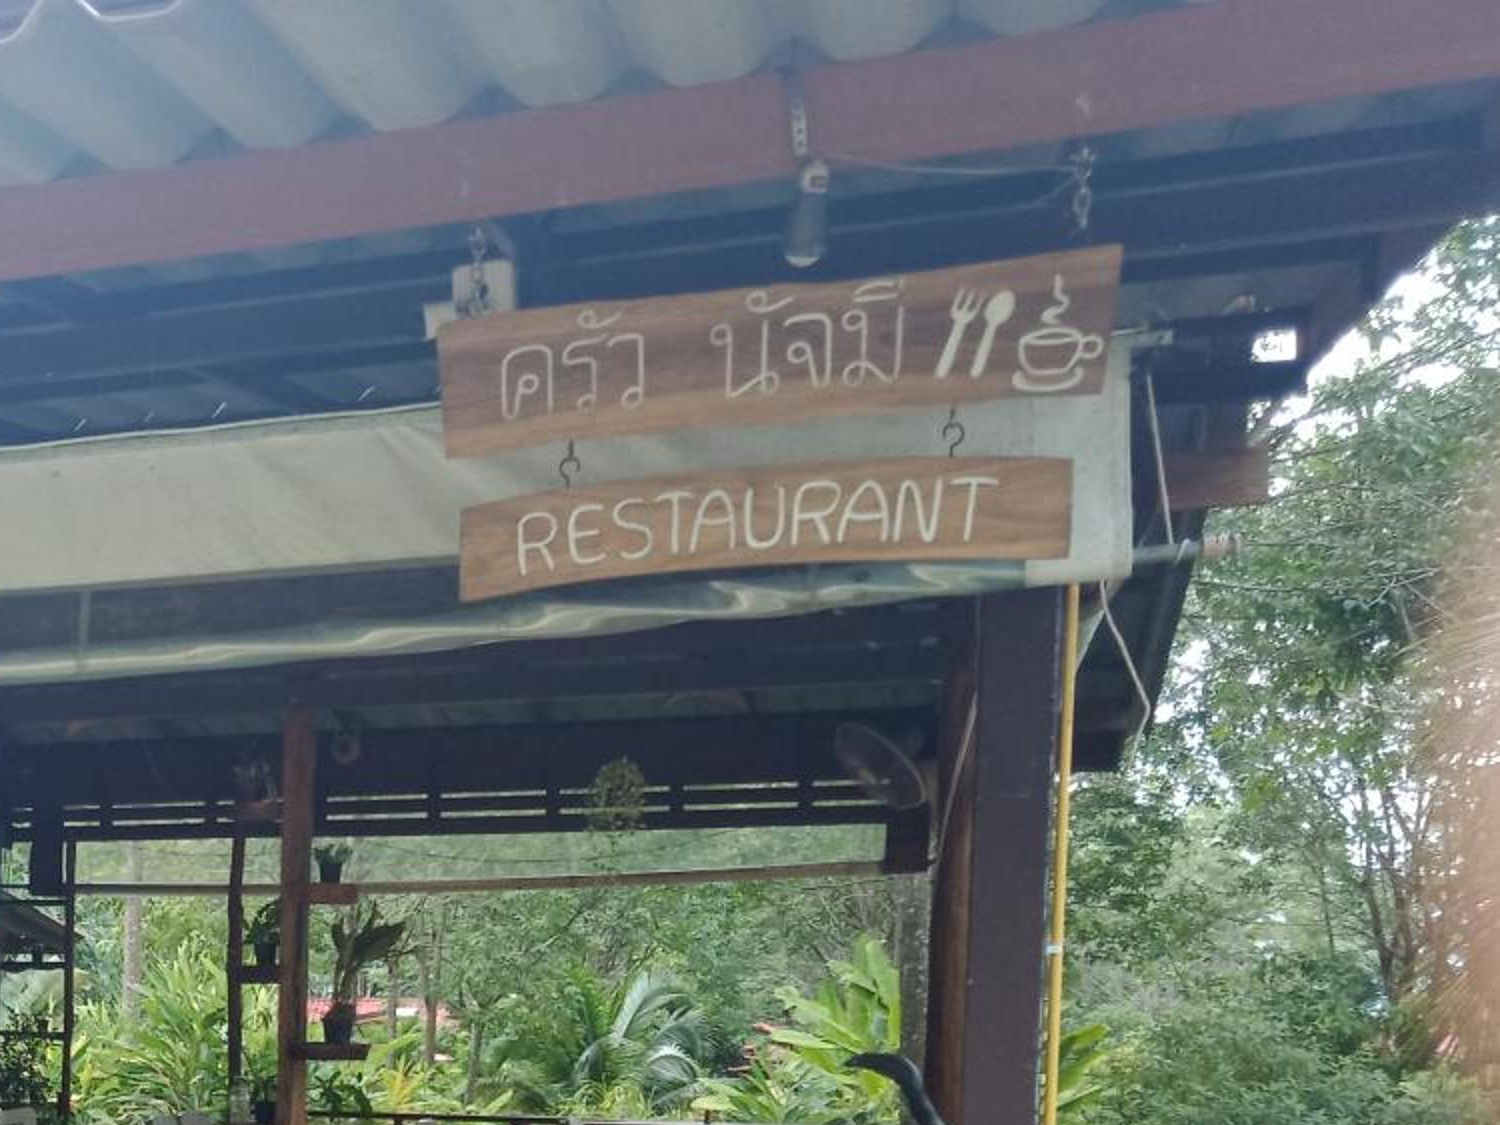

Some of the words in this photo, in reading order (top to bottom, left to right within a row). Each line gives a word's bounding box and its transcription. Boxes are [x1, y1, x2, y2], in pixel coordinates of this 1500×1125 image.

[501, 309, 645, 419] ครัว
[709, 280, 904, 398] นัจมี
[516, 476, 999, 576] RESTAURANT
